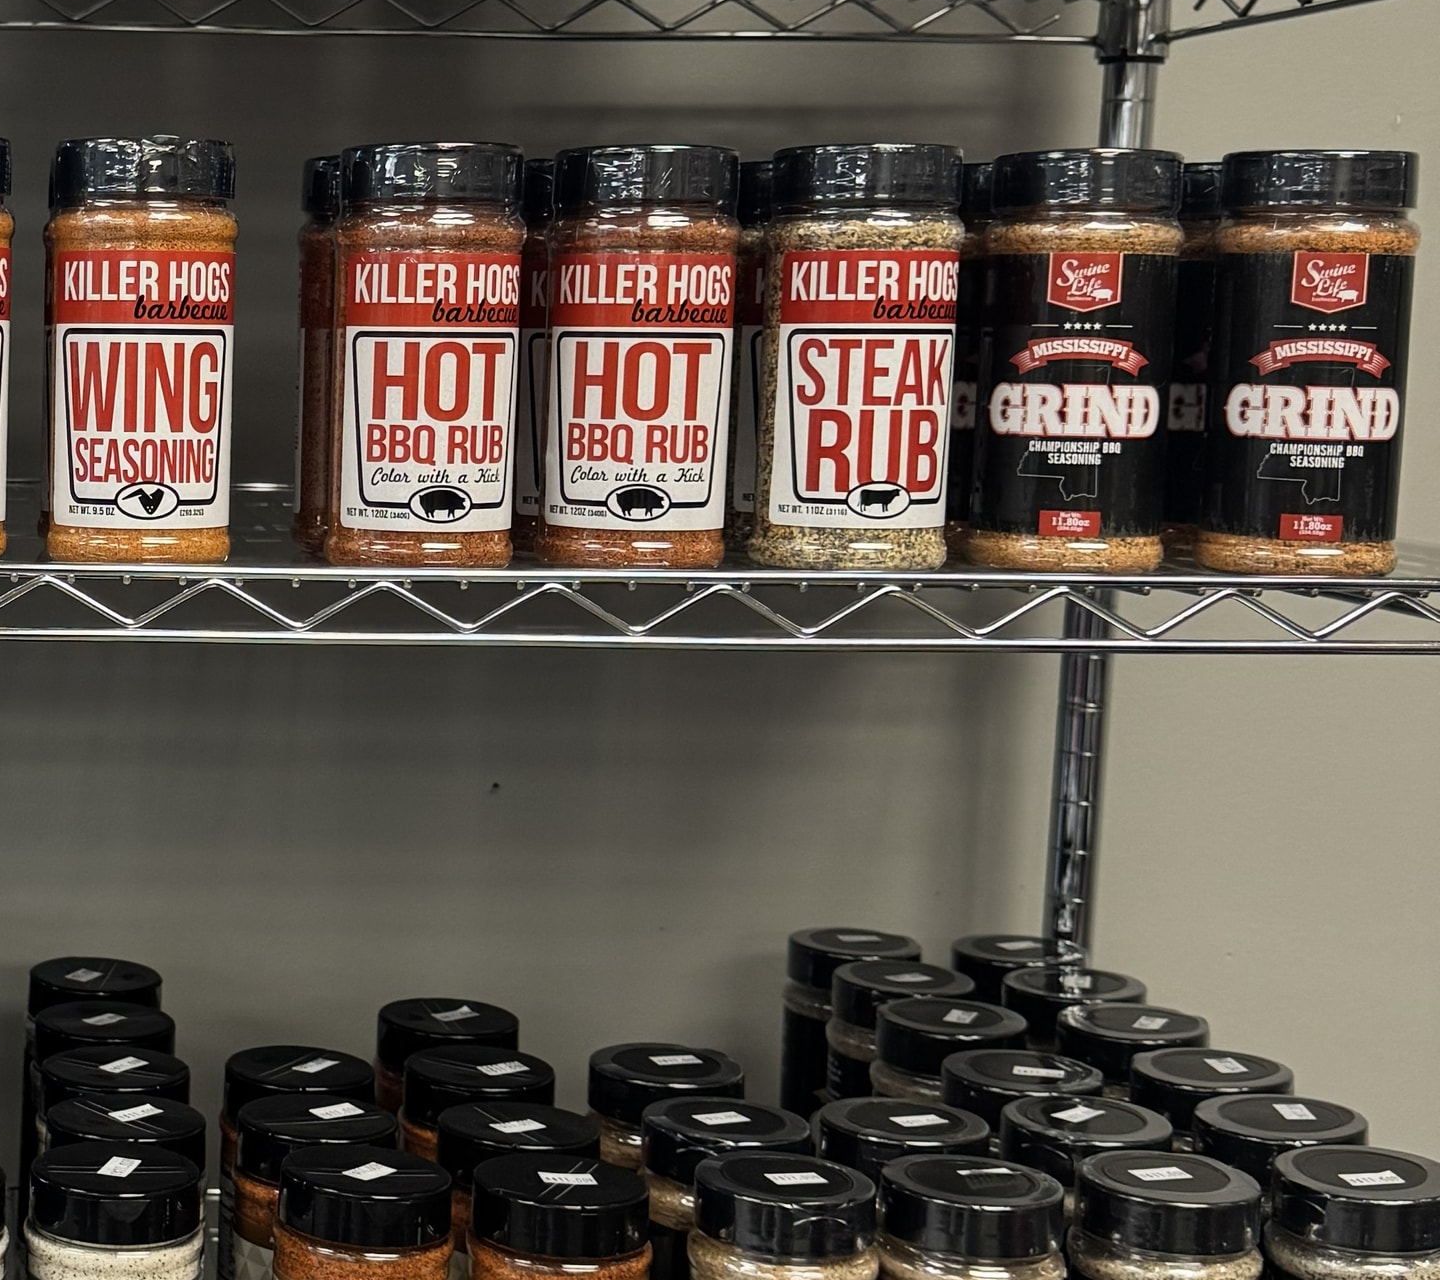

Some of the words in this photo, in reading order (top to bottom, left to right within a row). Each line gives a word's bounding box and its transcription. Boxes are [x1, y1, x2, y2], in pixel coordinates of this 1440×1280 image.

[354, 261, 457, 304] KILLER
[466, 264, 520, 306] HOGS
[1056, 258, 1111, 287] Swine
[1032, 339, 1129, 360] MISSISSIPPI
[1276, 341, 1373, 361] MISSISSIPPI
[70, 340, 219, 434] WING
[371, 340, 506, 421] HOT
[571, 341, 713, 421] HOT
[796, 338, 950, 407] STEAK
[988, 382, 1161, 439] GRIND
[1224, 382, 1400, 441] GRIND
[366, 423, 437, 466] BBQ
[446, 425, 503, 464] RUB
[804, 409, 940, 494] RUB
[1028, 440, 1100, 455] CHAMPIONSHIP
[1102, 441, 1122, 454] BBQ
[1047, 452, 1102, 466] SEASONING
[370, 467, 411, 486] Color
[417, 468, 452, 485] with
[456, 471, 469, 484] a
[474, 468, 502, 484] Kick
